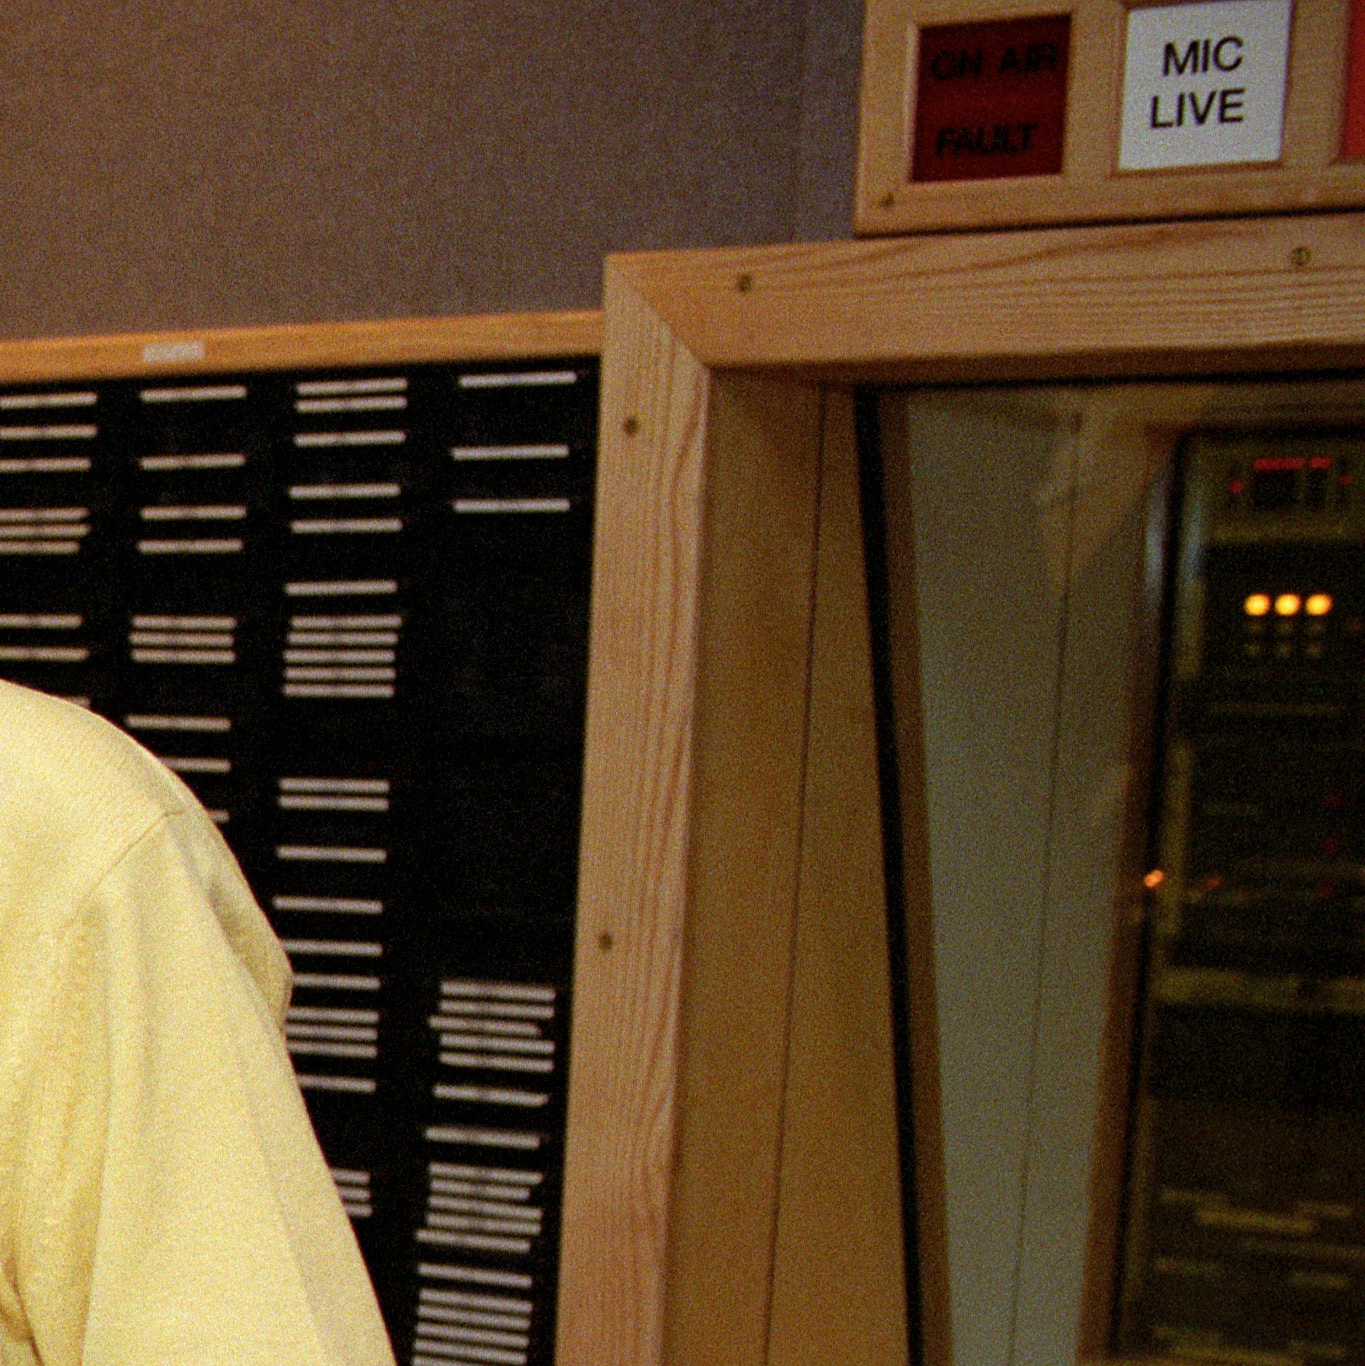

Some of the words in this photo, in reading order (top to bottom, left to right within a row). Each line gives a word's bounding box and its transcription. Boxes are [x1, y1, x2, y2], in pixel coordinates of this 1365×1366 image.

[930, 48, 984, 81] ON
[998, 42, 1058, 74] AIR
[1162, 35, 1245, 78] MIC
[1149, 87, 1246, 130] LIVE
[935, 121, 1038, 159] FAULT
